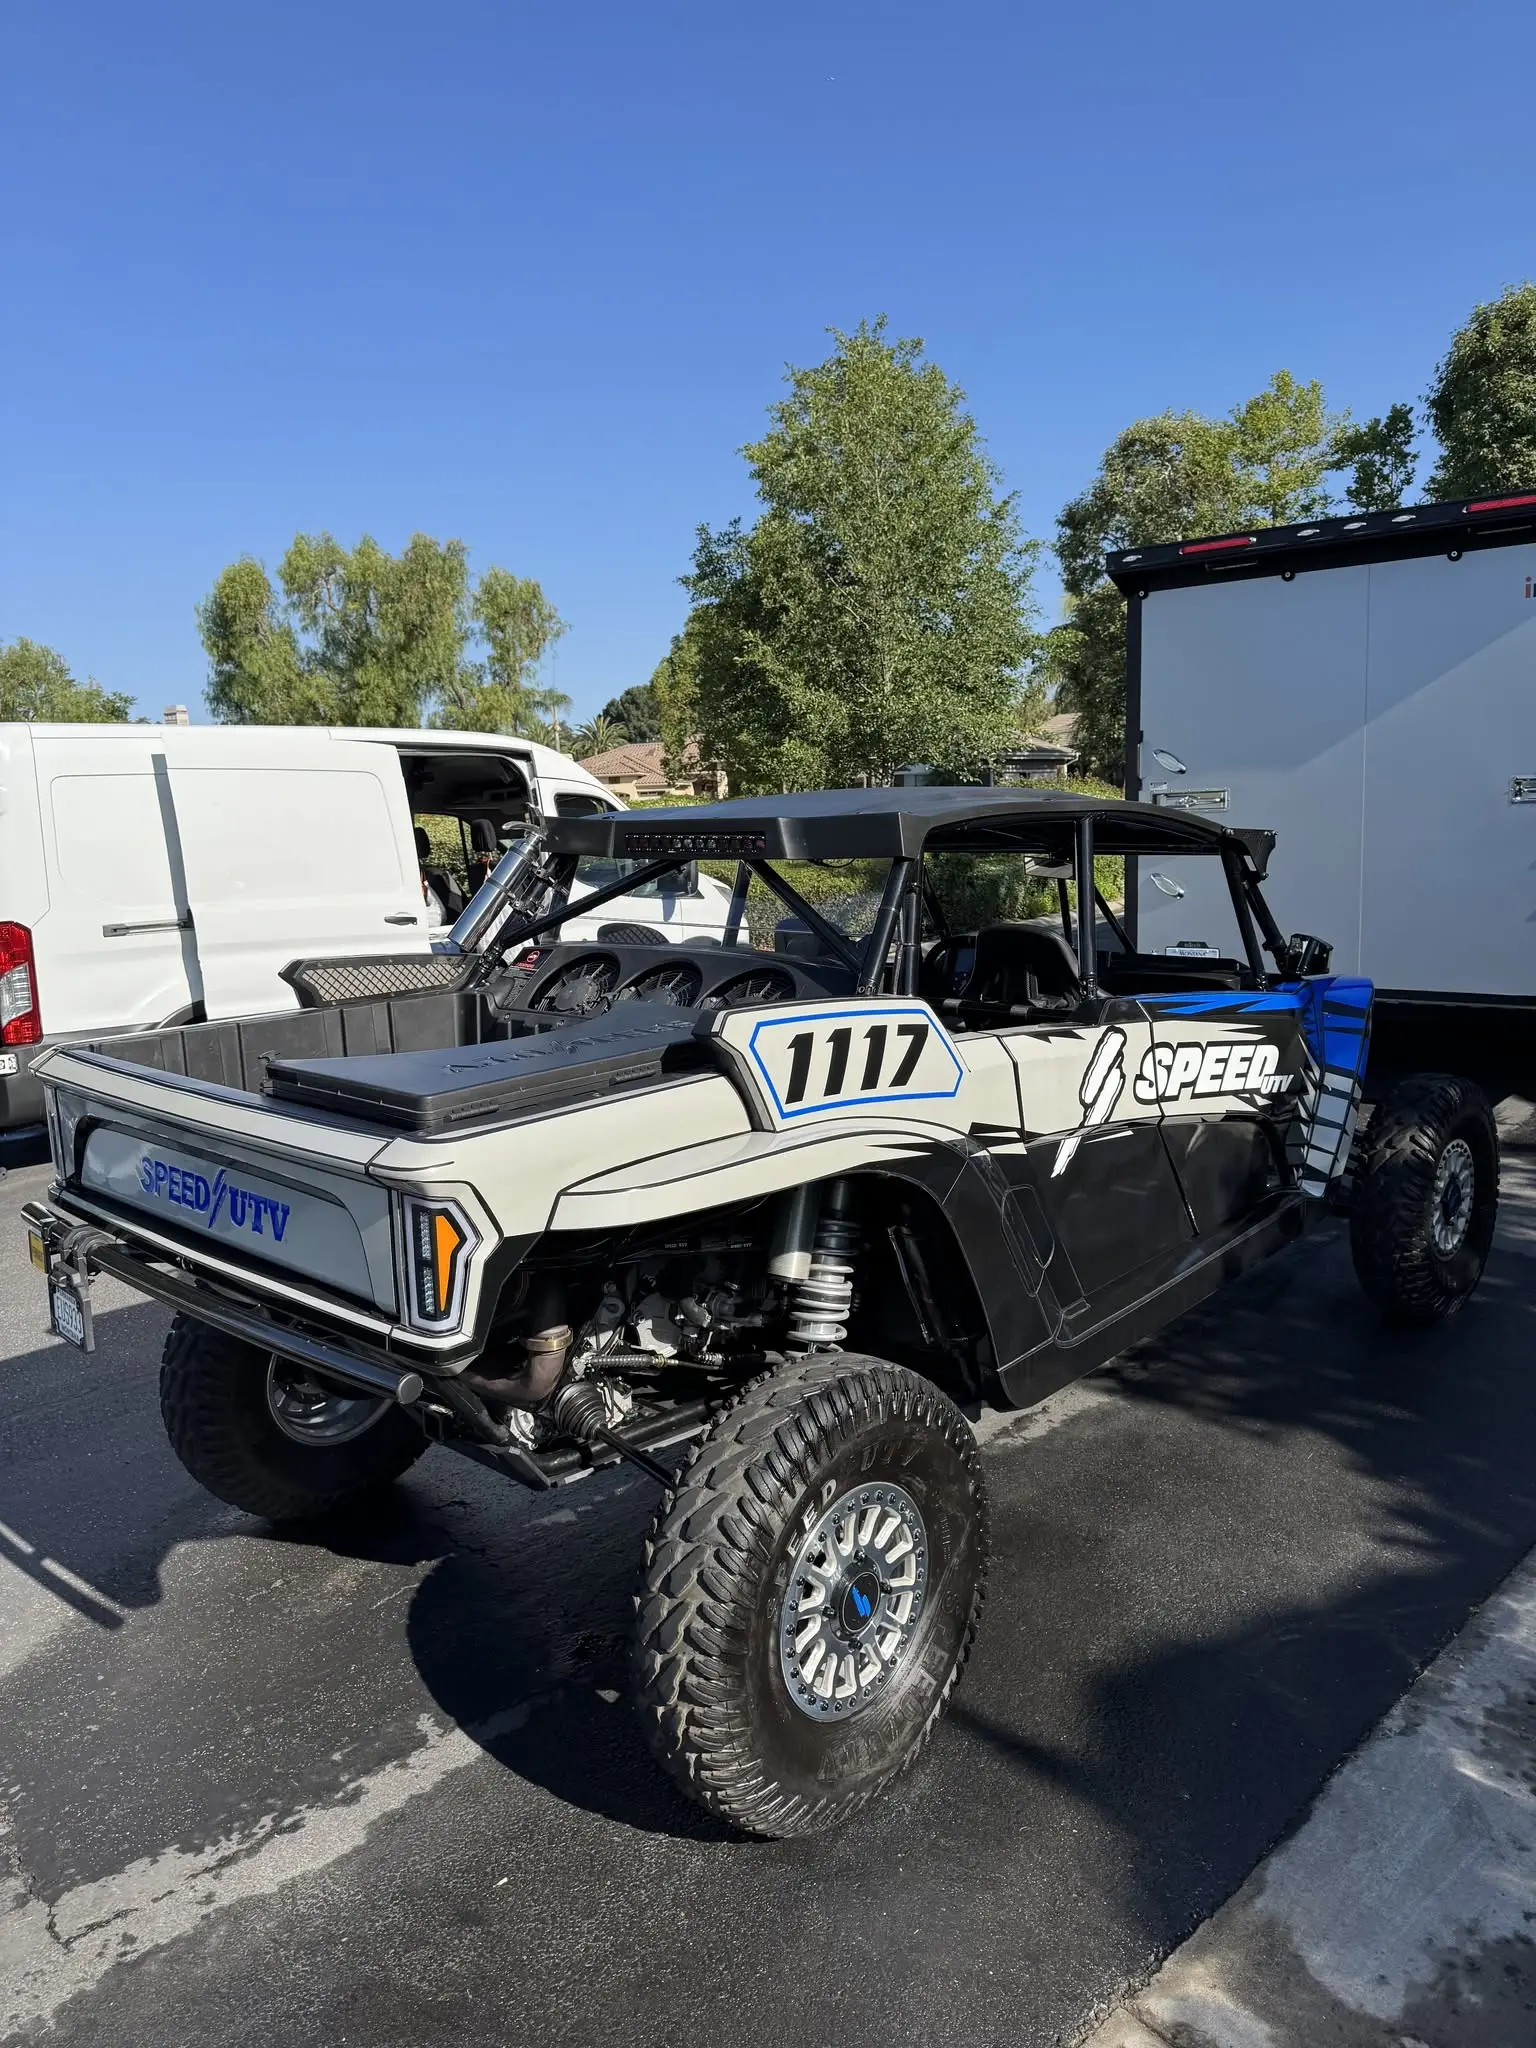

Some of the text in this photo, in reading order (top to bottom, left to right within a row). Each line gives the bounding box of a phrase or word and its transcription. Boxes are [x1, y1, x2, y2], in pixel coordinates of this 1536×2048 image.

[785, 1024, 929, 1104] 1117
[1135, 1044, 1294, 1101] SPEED UTV
